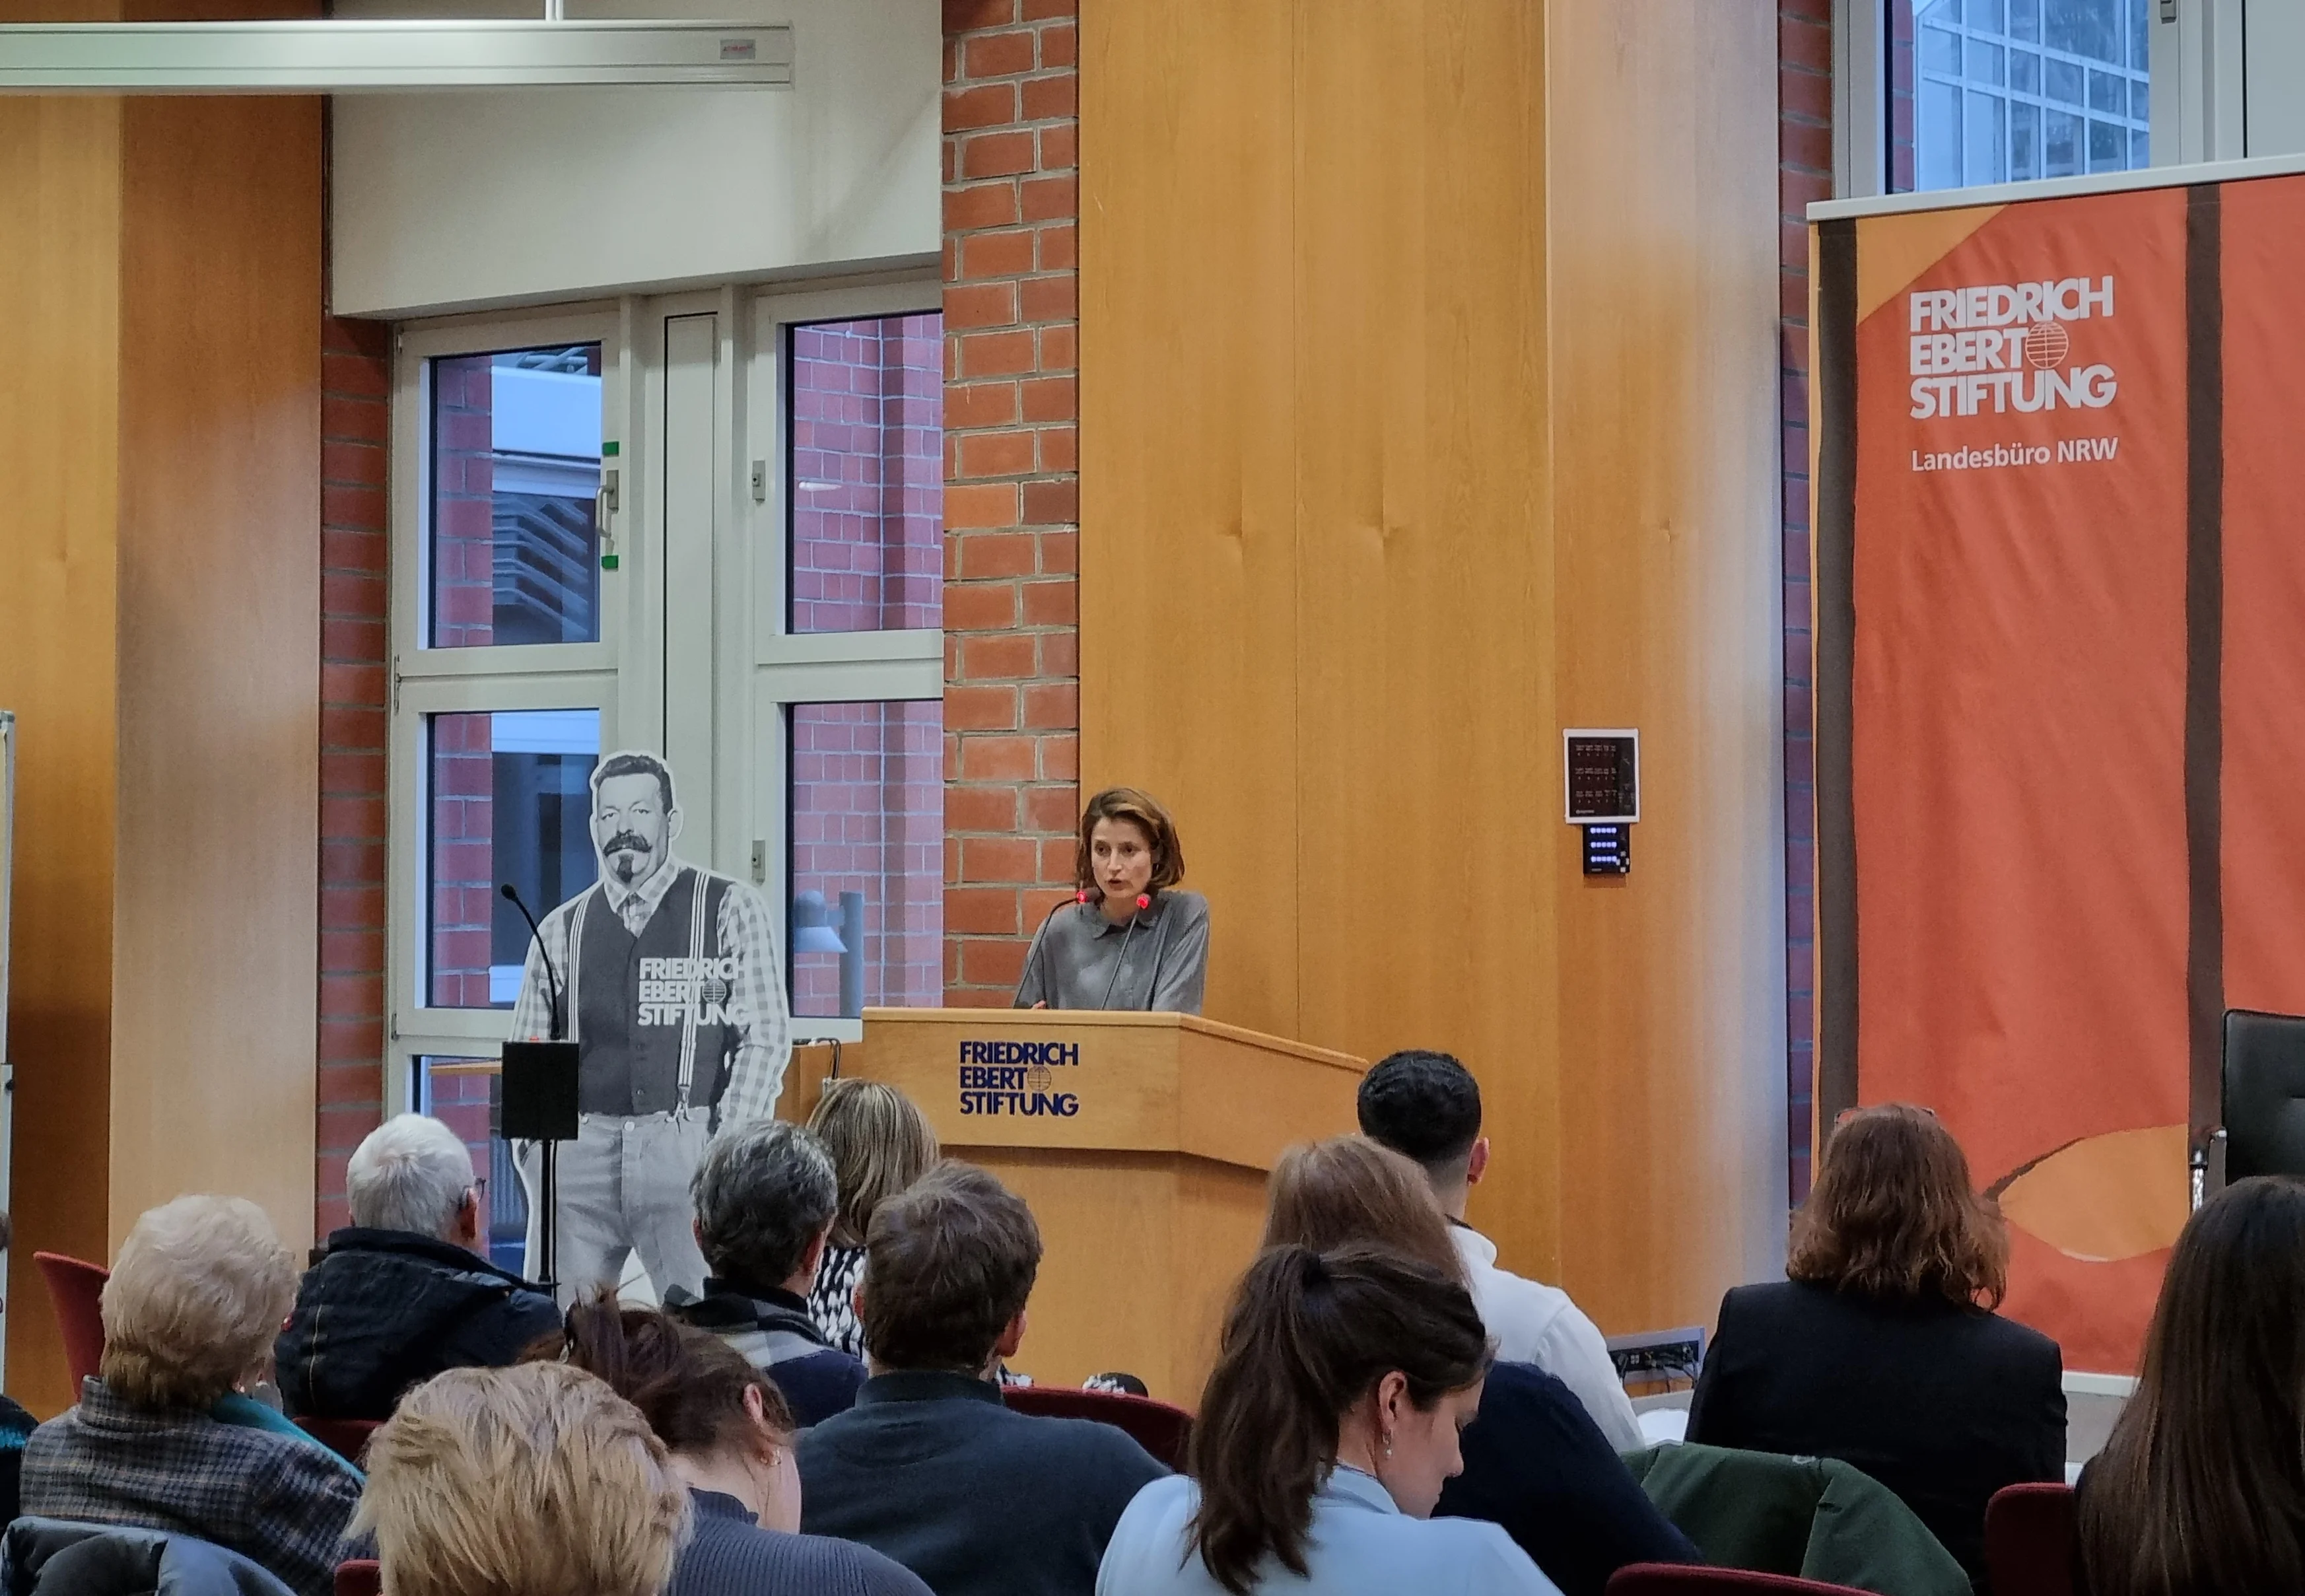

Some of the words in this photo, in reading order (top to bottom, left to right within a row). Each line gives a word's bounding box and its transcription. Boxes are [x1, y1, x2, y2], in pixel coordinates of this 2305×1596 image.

[1910, 275, 2114, 332] FRIEDRICH
[1910, 328, 2029, 376] EBERT
[1910, 364, 2117, 419] STIFTUNG
[1911, 442, 2051, 472] Landesbüro
[2057, 437, 2118, 463] NRW
[638, 981, 705, 1002] EBERT
[959, 1041, 1079, 1066] FRIEDRICH
[959, 1066, 1028, 1090] EBERT
[959, 1091, 1080, 1117] STIFTUNG
